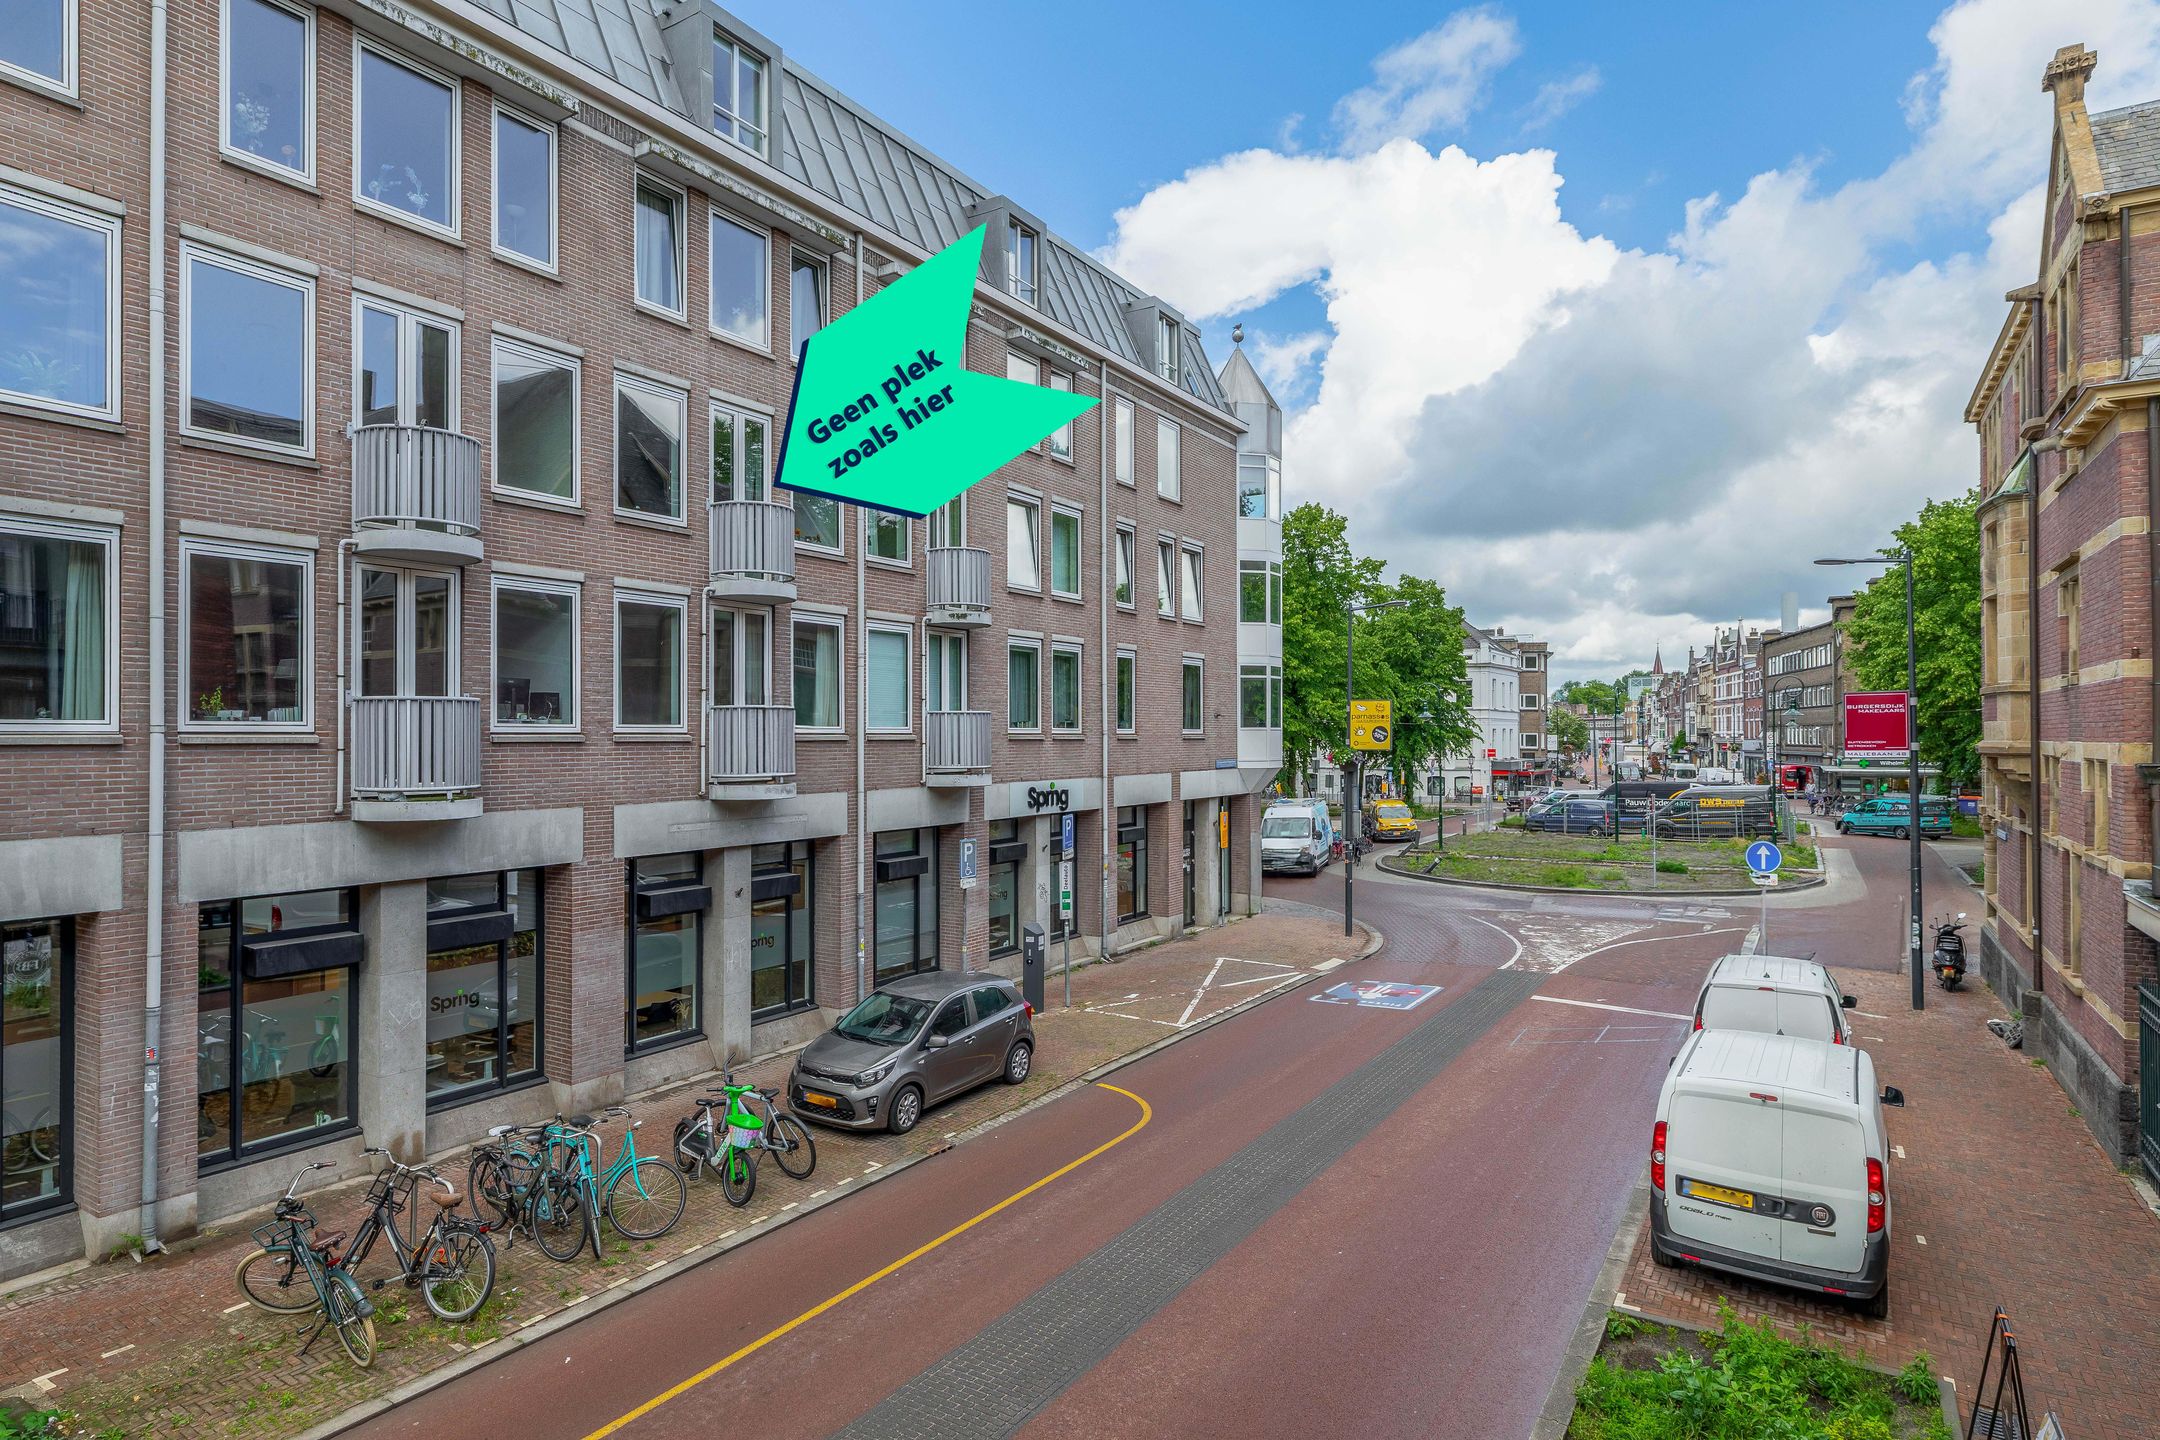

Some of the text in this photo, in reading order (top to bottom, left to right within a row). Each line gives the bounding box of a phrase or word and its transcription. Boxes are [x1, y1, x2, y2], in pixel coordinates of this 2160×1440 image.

[1027, 781, 1069, 813] Spring
[1065, 819, 1072, 837] P
[964, 842, 973, 863] P
[751, 932, 775, 951] pring
[430, 989, 480, 1013] Spring
